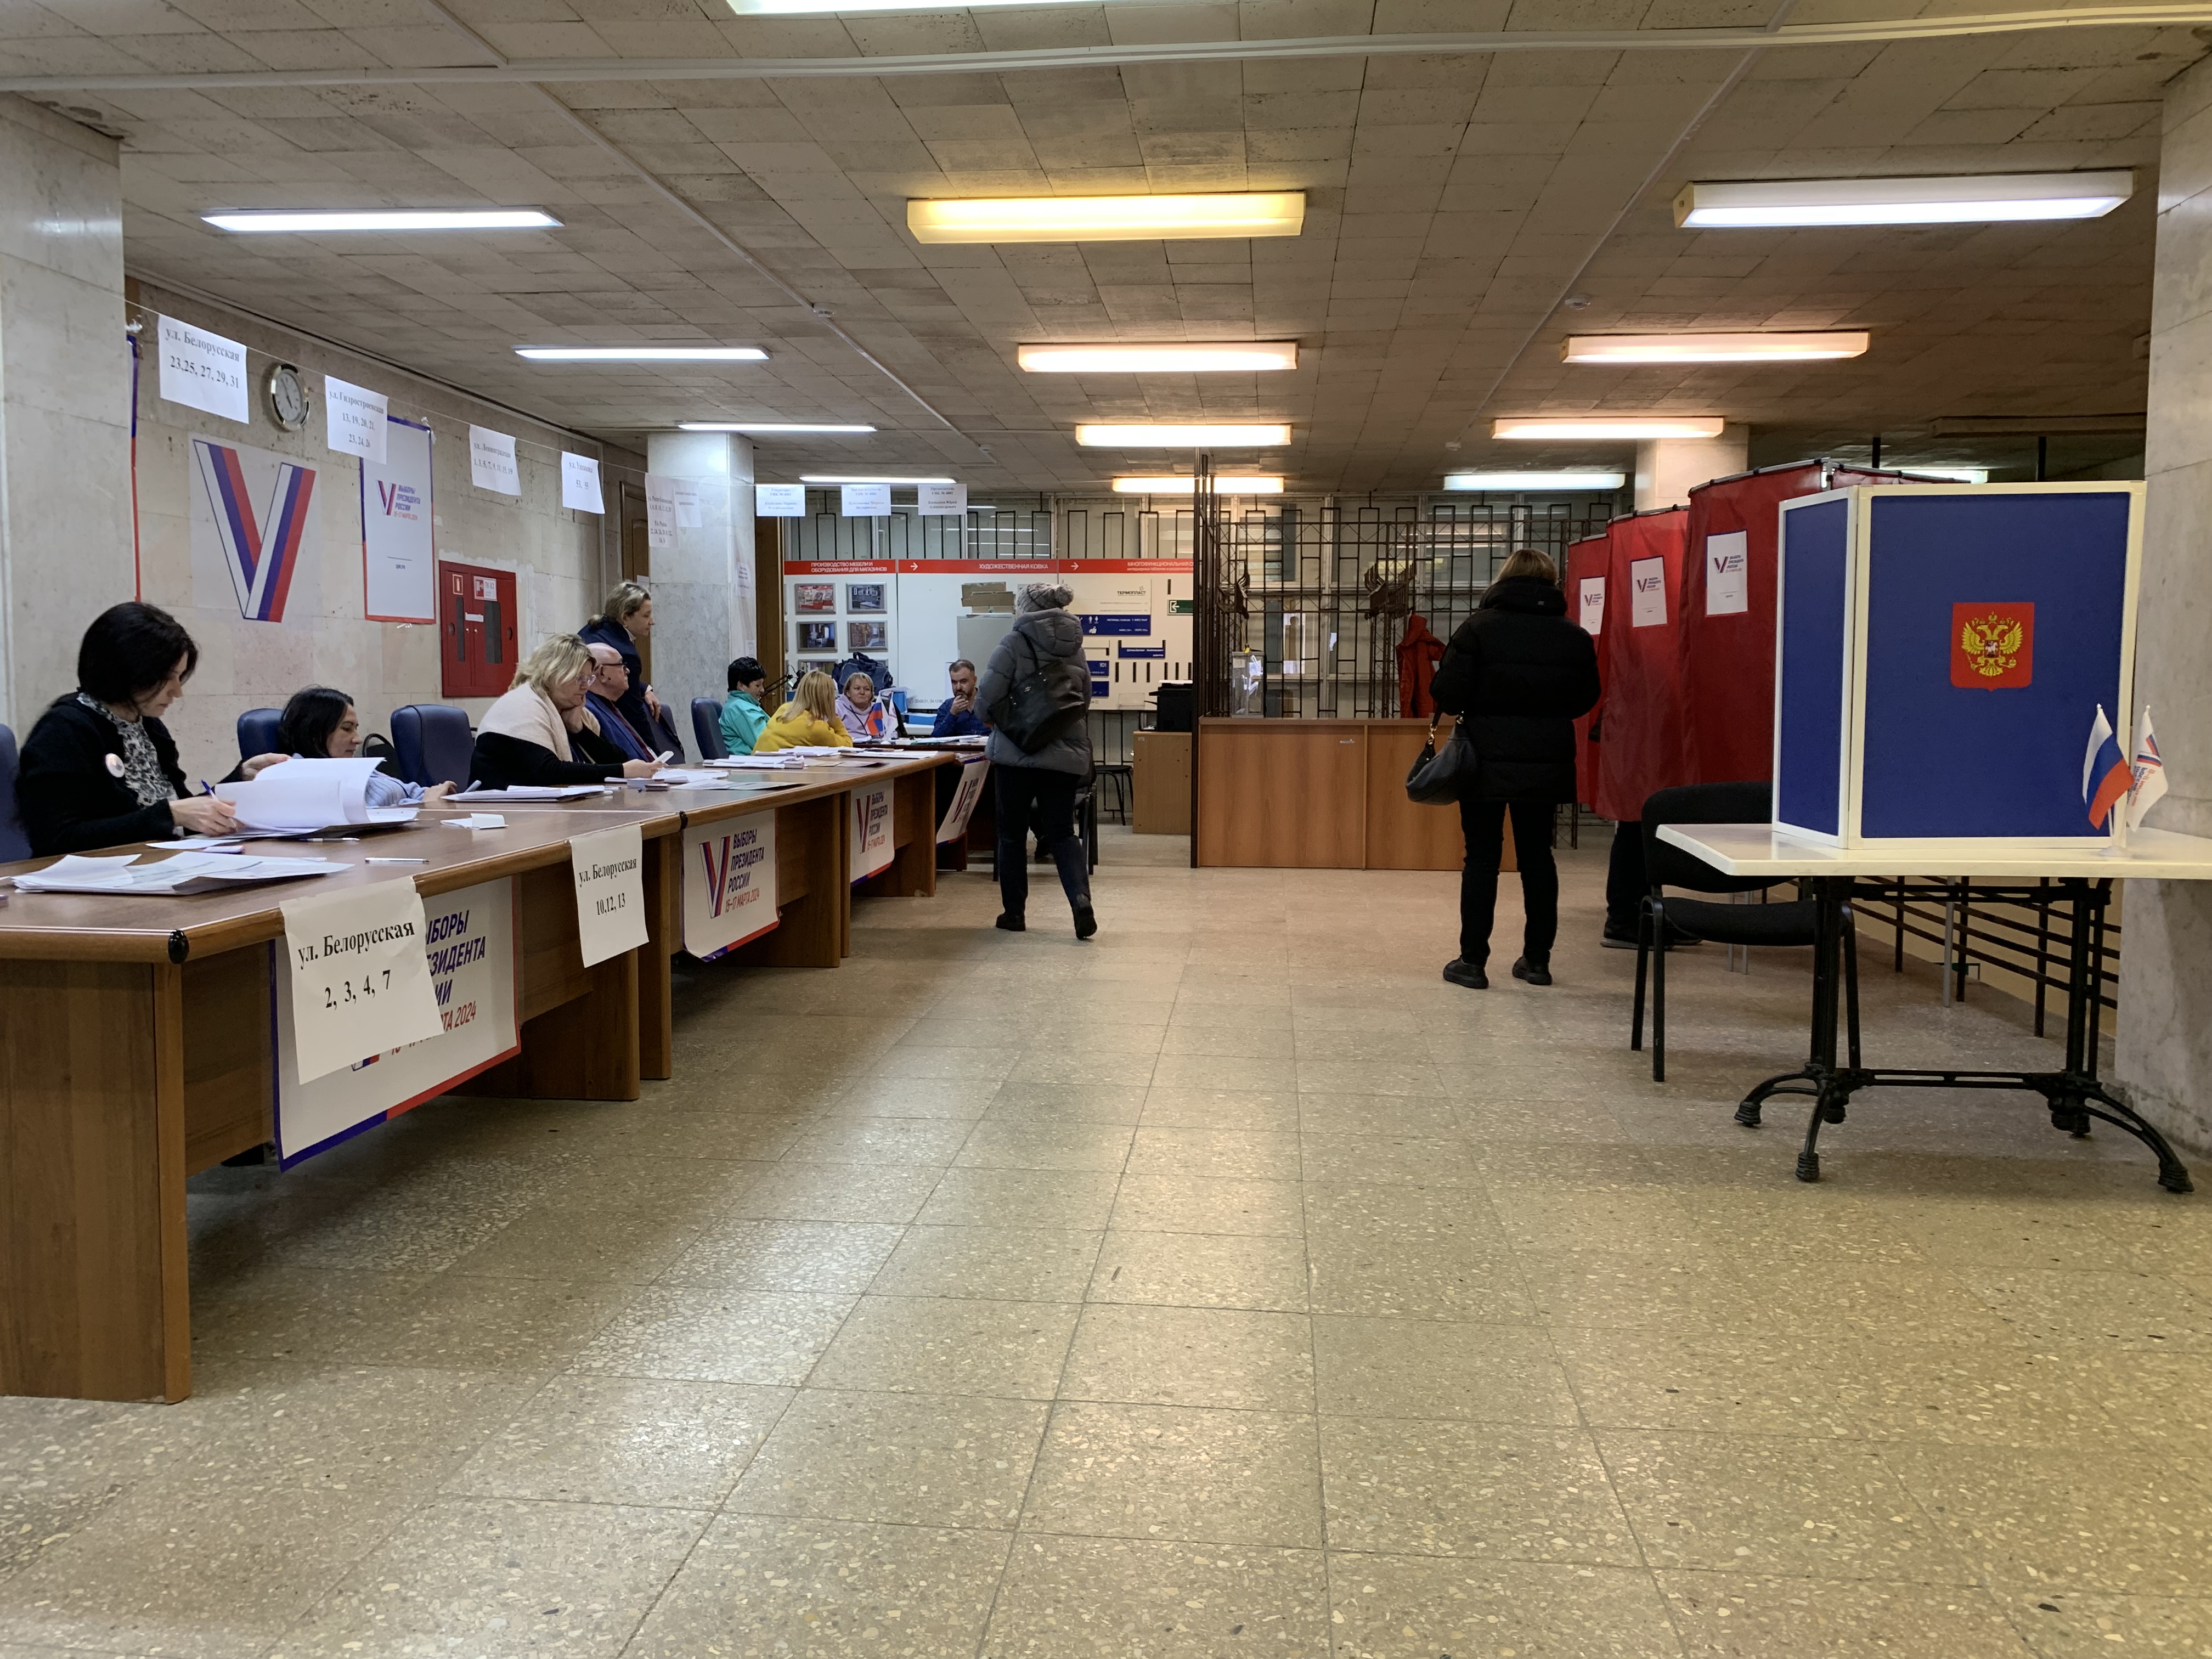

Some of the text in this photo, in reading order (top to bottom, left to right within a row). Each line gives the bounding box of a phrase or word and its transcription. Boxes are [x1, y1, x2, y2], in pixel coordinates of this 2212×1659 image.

[165, 329, 240, 362] ул. Белорусская
[201, 366, 214, 381] 27,
[217, 370, 228, 386] 29,
[230, 376, 239, 388] 31
[329, 391, 384, 414] ул. Гидростроевская
[733, 828, 757, 850] ВЫБОРЫ
[731, 847, 764, 872] ПРЕЗИДЕНТА
[579, 858, 637, 888] ул. Белорусская
[727, 871, 751, 894] РОССИИ
[618, 893, 625, 909] 13
[736, 890, 750, 909] МАРТА
[750, 888, 760, 904] 2024
[426, 909, 470, 945] БОРЫ
[298, 921, 415, 970] ул. Белорусская
[427, 936, 486, 977] ЗИДЕНТА
[325, 969, 391, 1011] 2, 3, 4, 7
[454, 1000, 476, 1028] 2024
